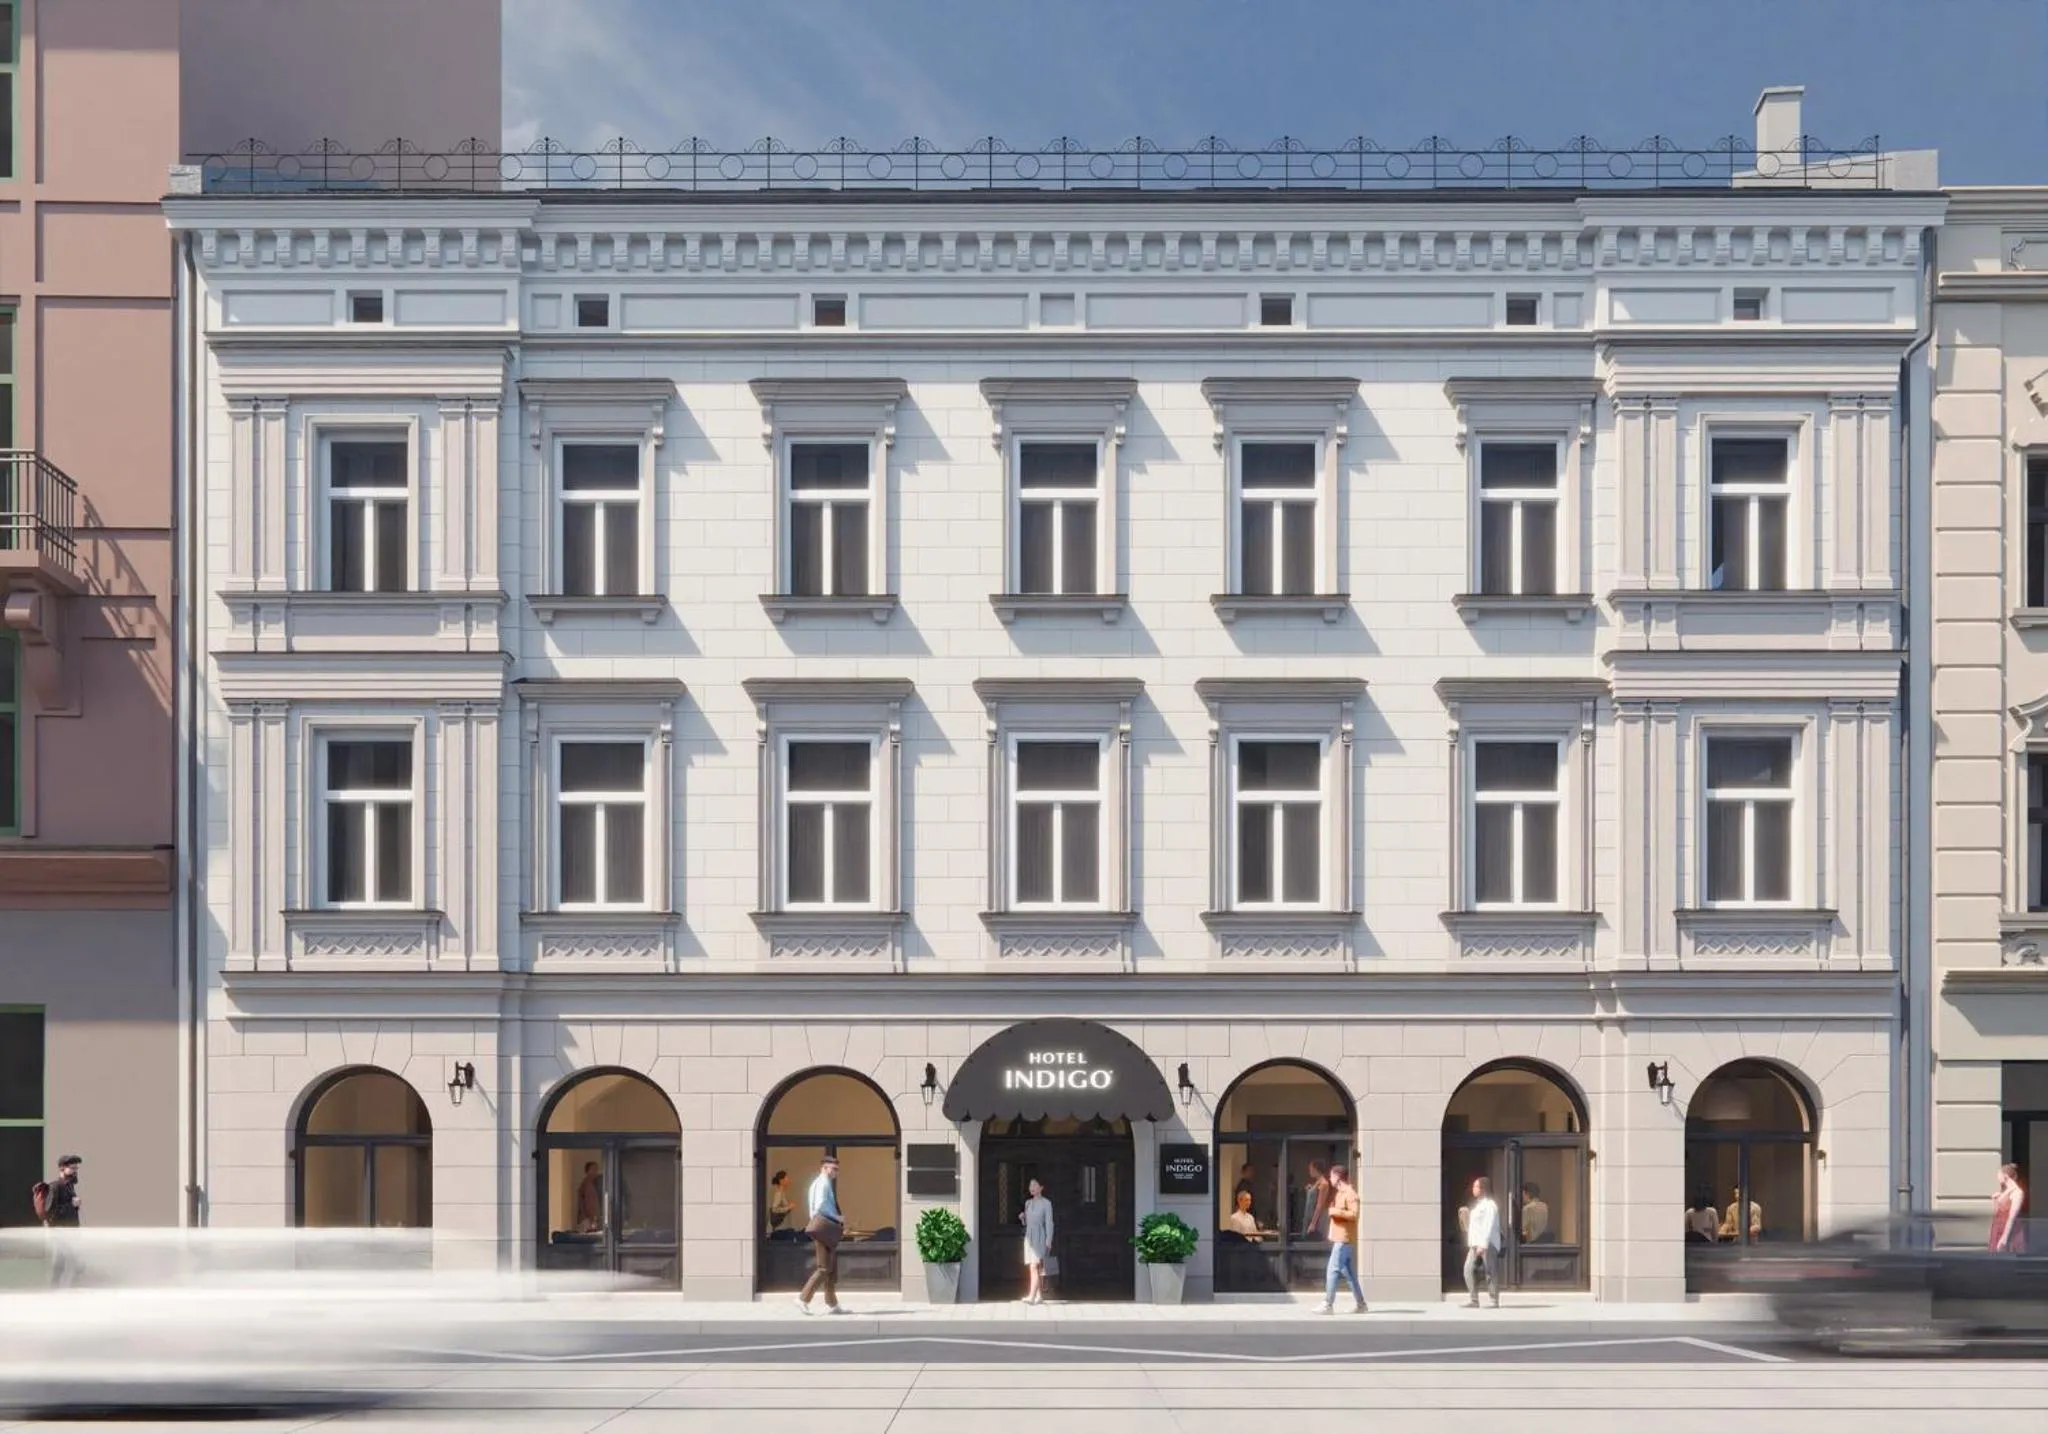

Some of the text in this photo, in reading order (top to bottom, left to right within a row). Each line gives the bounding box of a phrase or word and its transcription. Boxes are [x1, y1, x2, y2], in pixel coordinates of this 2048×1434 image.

[1029, 1052, 1088, 1065] HOTEL
[1005, 1069, 1112, 1089] INDIGO
[1165, 1164, 1203, 1173] INDIGO
